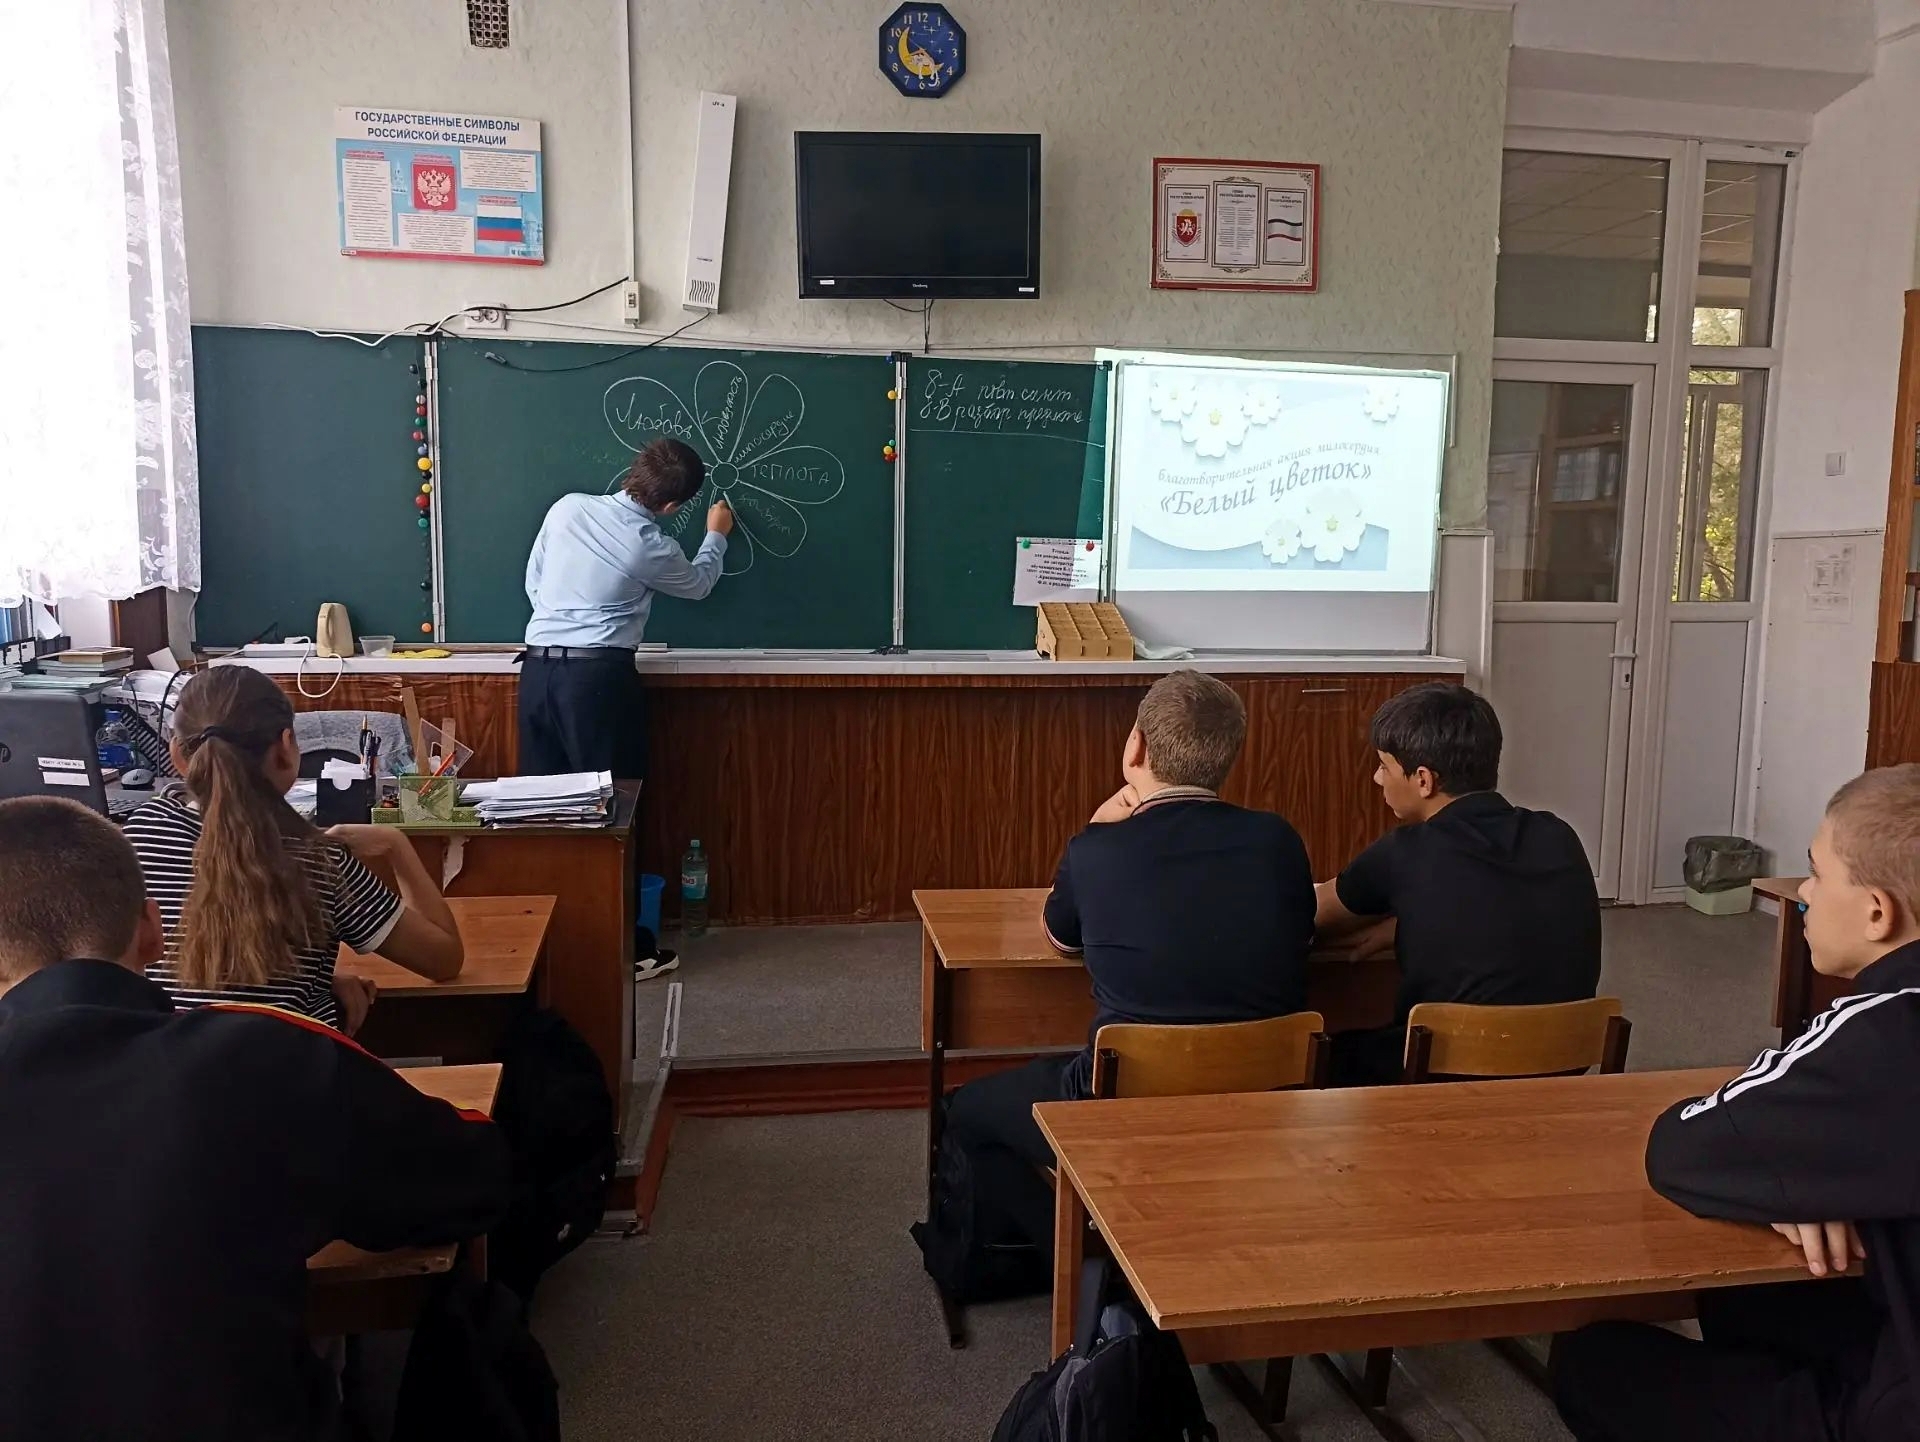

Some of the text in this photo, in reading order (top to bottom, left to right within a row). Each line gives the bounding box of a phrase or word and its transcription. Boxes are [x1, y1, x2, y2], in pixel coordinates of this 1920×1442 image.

[904, 15, 912, 24] 11
[918, 13, 928, 23] 12
[938, 17, 941, 26] 1
[891, 28, 901, 37] 10
[948, 31, 954, 41] 2
[888, 45, 894, 53] 9
[952, 48, 958, 57] 3
[892, 62, 899, 72] 8
[946, 66, 953, 76] 4
[904, 75, 910, 85] 7
[919, 81, 925, 90] 6
[355, 111, 520, 131] ГОСУДАРСТВЕННЫЕ СИМВОЛЫ
[367, 127, 507, 145] РОССИЙСКОЙ ФЕДЕРАЦИИ
[1277, 447, 1312, 464] акция
[1318, 441, 1379, 457] милосердия
[1160, 460, 1372, 517] «Белый цветок»
